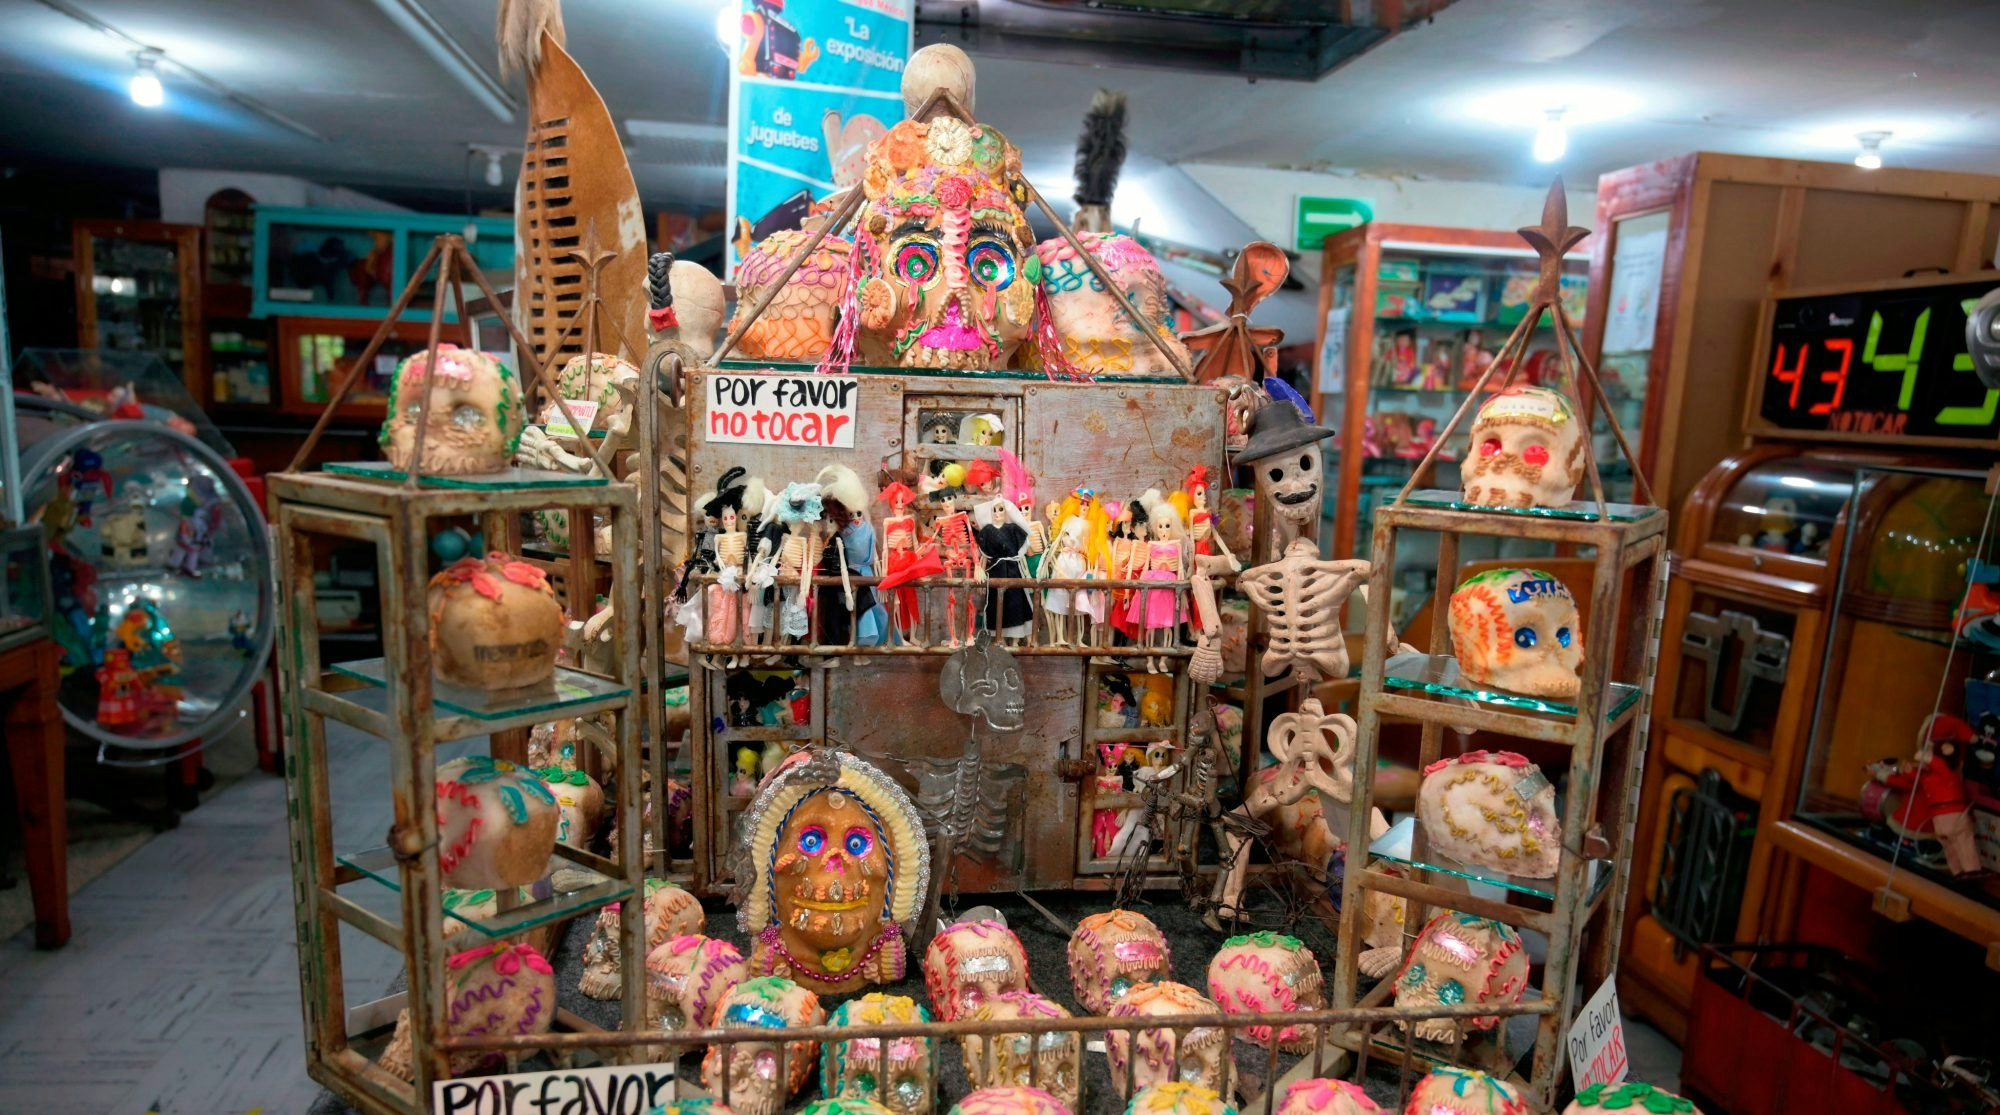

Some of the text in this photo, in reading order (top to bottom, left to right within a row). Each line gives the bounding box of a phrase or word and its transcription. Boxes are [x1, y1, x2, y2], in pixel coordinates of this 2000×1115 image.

[826, 37, 904, 73] exposición
[773, 108, 792, 126] de
[747, 121, 819, 152] juguetes
[715, 377, 858, 410] Por favor
[1772, 338, 1854, 415] 43
[1571, 992, 1616, 1073] Por favor
[442, 1072, 675, 1115] Por favor
